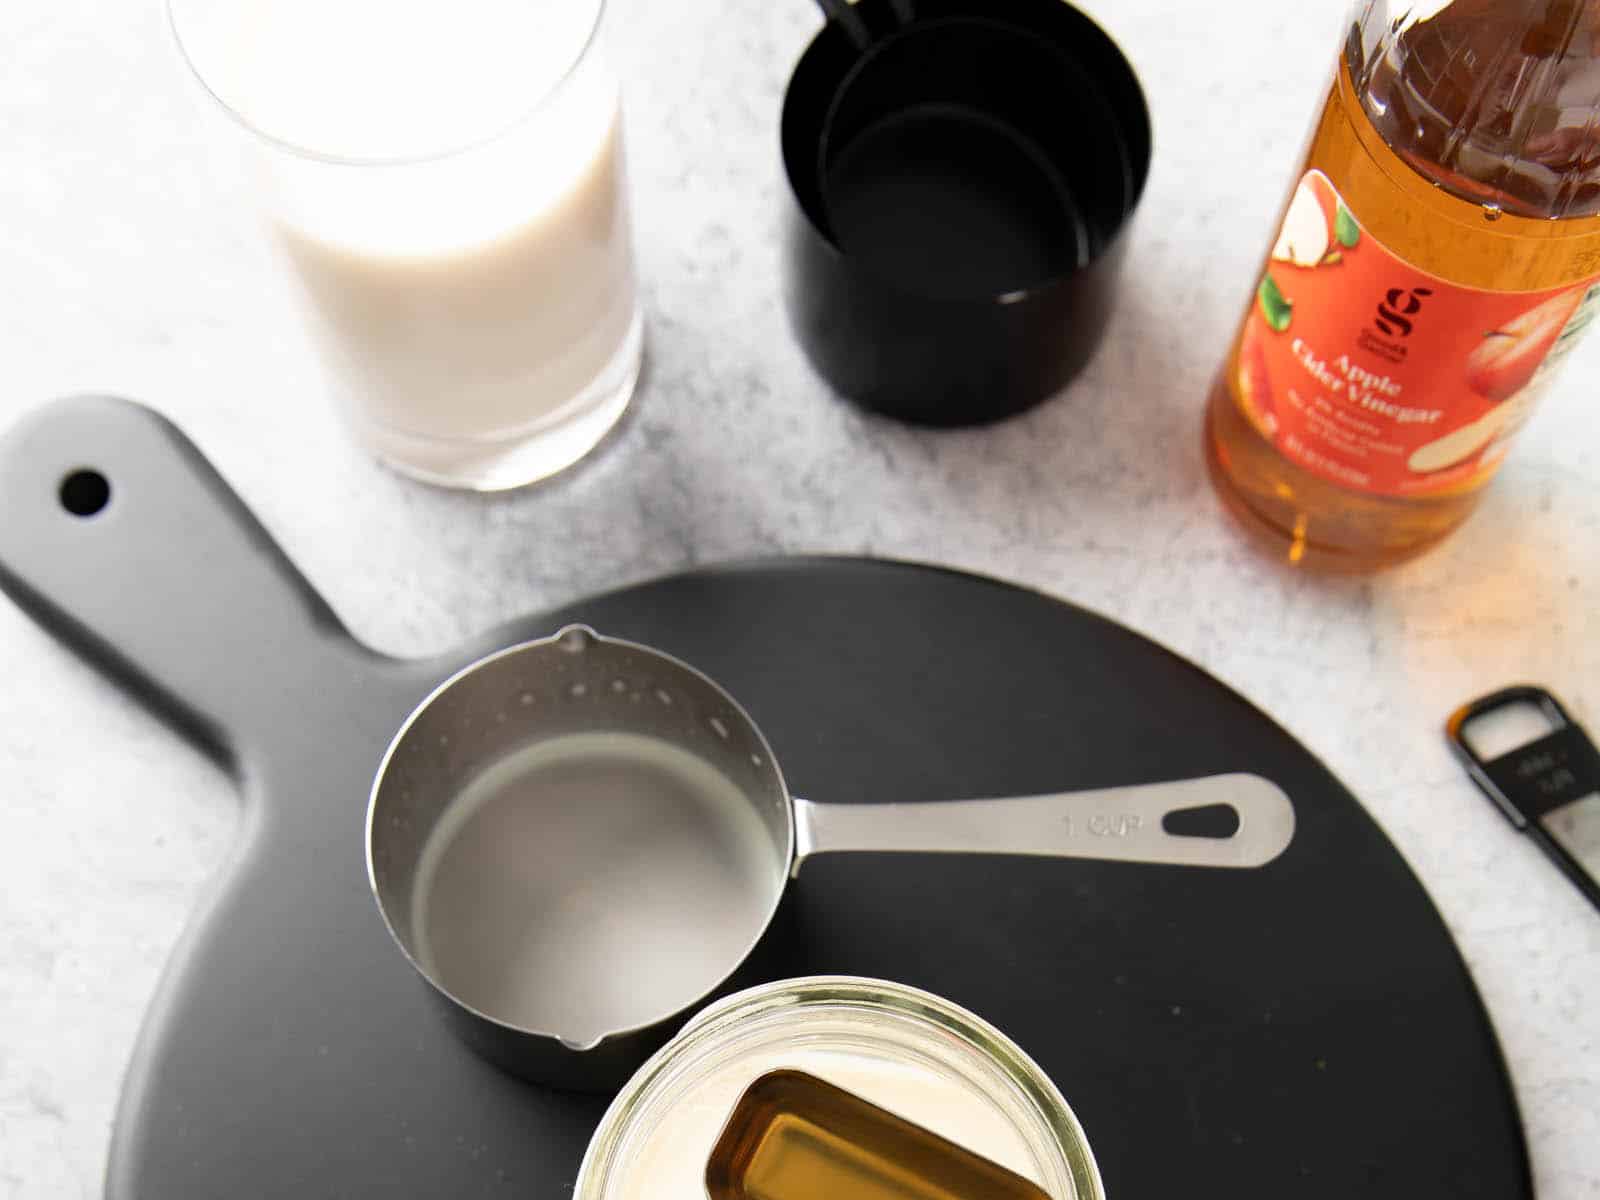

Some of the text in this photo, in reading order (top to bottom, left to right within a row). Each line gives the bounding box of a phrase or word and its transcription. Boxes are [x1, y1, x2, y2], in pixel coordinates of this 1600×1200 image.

[1291, 338, 1345, 393] Cider
[1346, 385, 1444, 424] Vinegar
[1335, 355, 1402, 396] Apple
[1087, 815, 1144, 837] CUP
